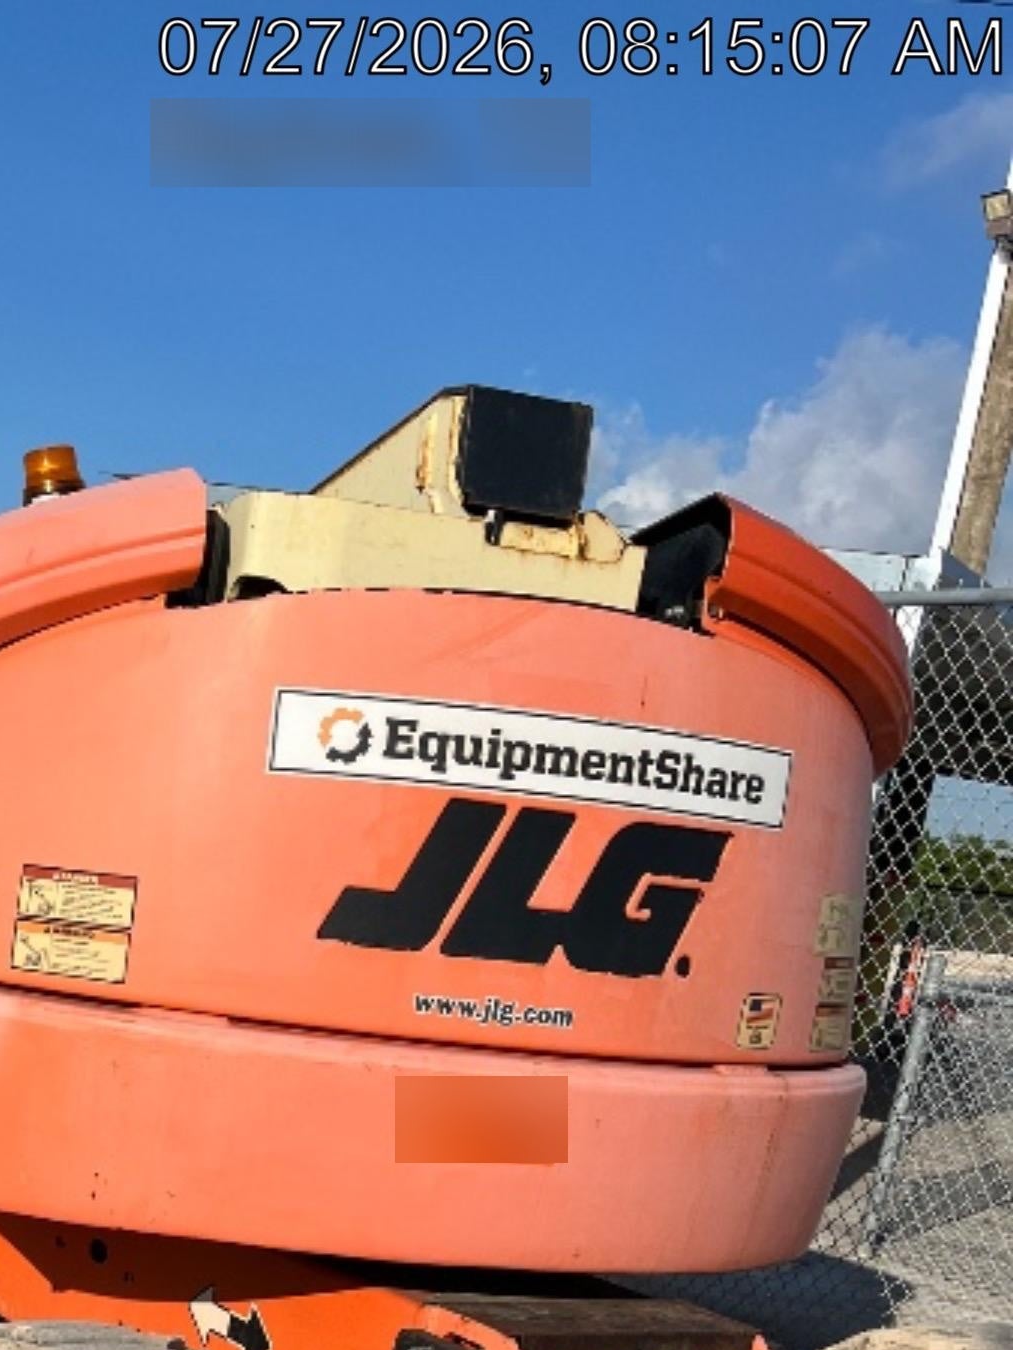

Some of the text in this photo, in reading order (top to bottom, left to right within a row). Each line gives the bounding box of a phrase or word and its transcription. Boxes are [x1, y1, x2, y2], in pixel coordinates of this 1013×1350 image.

[382, 715, 767, 806] EquipmentShare
[316, 797, 735, 978] JLG
[414, 995, 574, 1028] www.jlg.com
